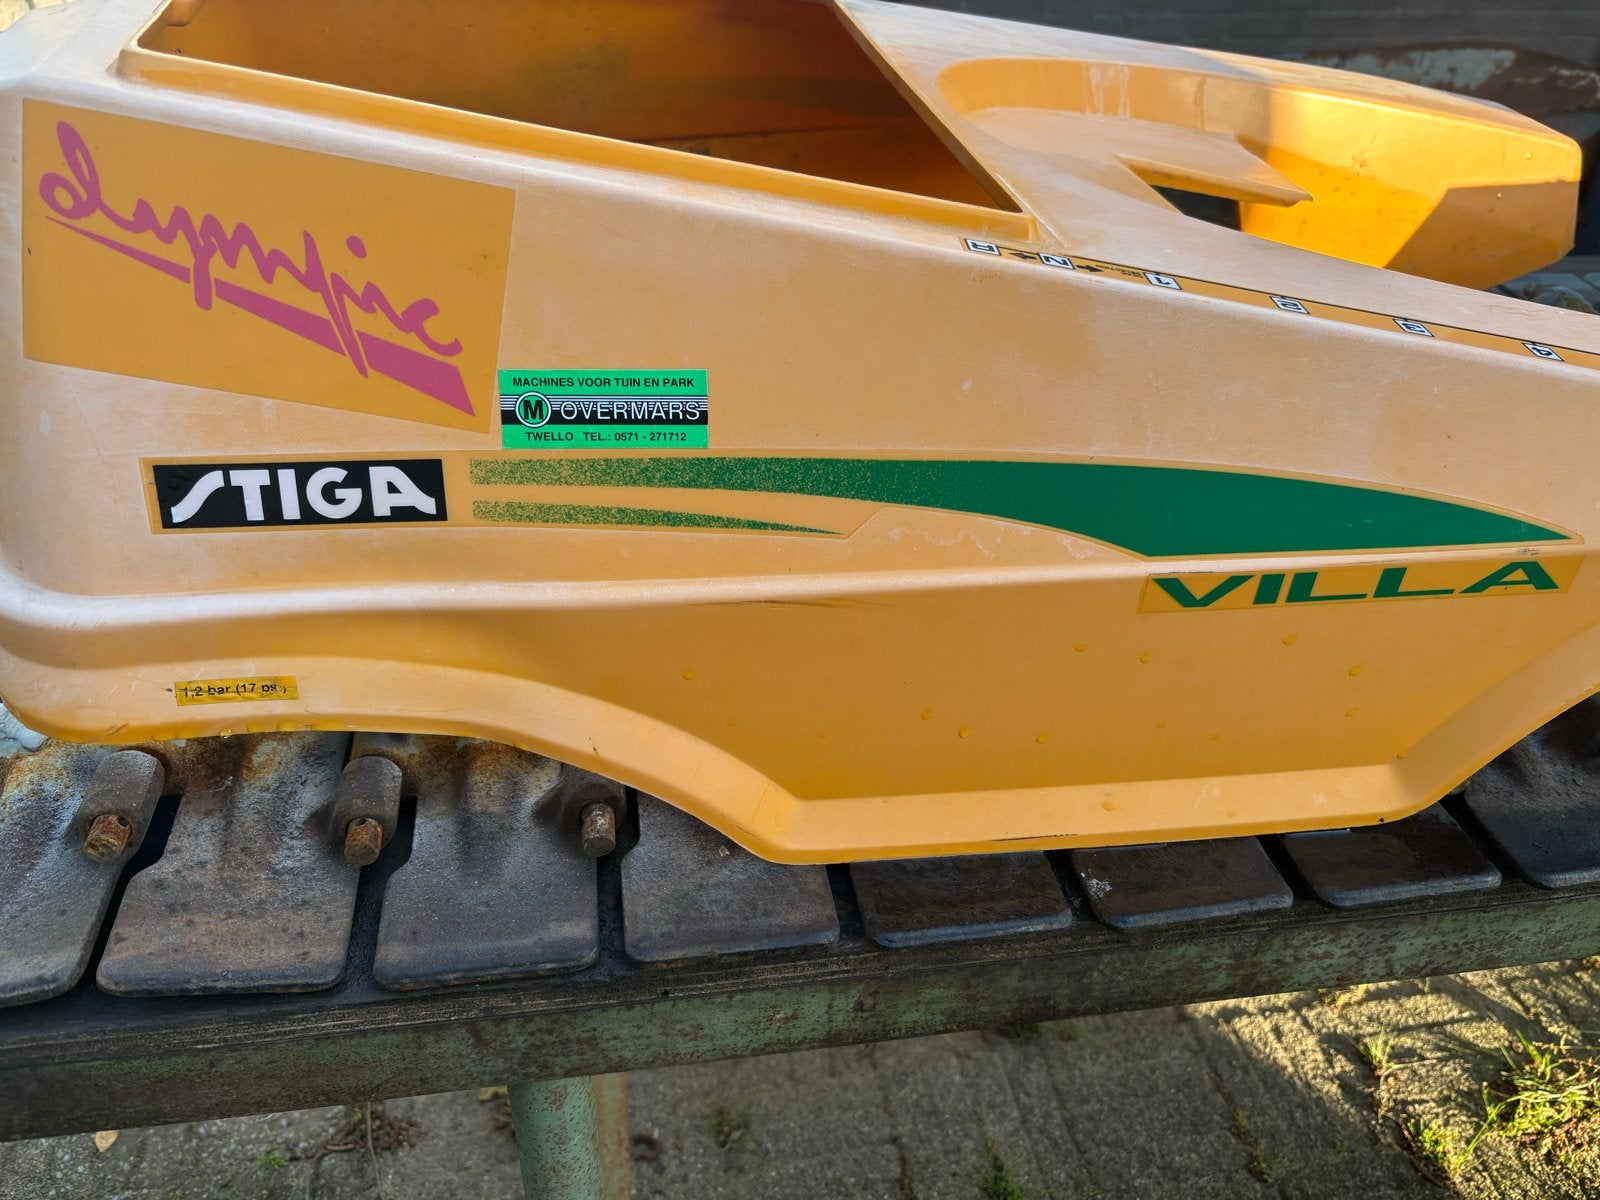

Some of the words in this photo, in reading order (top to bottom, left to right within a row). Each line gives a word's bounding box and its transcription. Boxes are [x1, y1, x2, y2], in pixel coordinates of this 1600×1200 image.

[970, 241, 996, 253] R
[1042, 255, 1070, 267] N
[1154, 276, 1171, 285] 1
[1277, 299, 1303, 311] 2
[1400, 322, 1426, 333] 3
[1531, 346, 1554, 356] 4
[512, 377, 574, 387] MACHINES
[577, 377, 611, 388] VOOR
[615, 377, 641, 388] TUIN
[644, 378, 660, 388] EN
[662, 378, 695, 388] PARK
[522, 399, 545, 420] M
[560, 401, 700, 420] OVERMARS
[526, 432, 574, 442] TWELLO
[583, 432, 611, 442] TEL.:
[614, 432, 639, 442] 0571
[649, 432, 687, 442] 271712
[171, 466, 437, 524] STIGA
[1151, 561, 1560, 608] VILLA
[183, 686, 204, 699] 1,2
[208, 685, 231, 696] bar
[236, 683, 256, 696] (17
[261, 682, 288, 696] ps)
